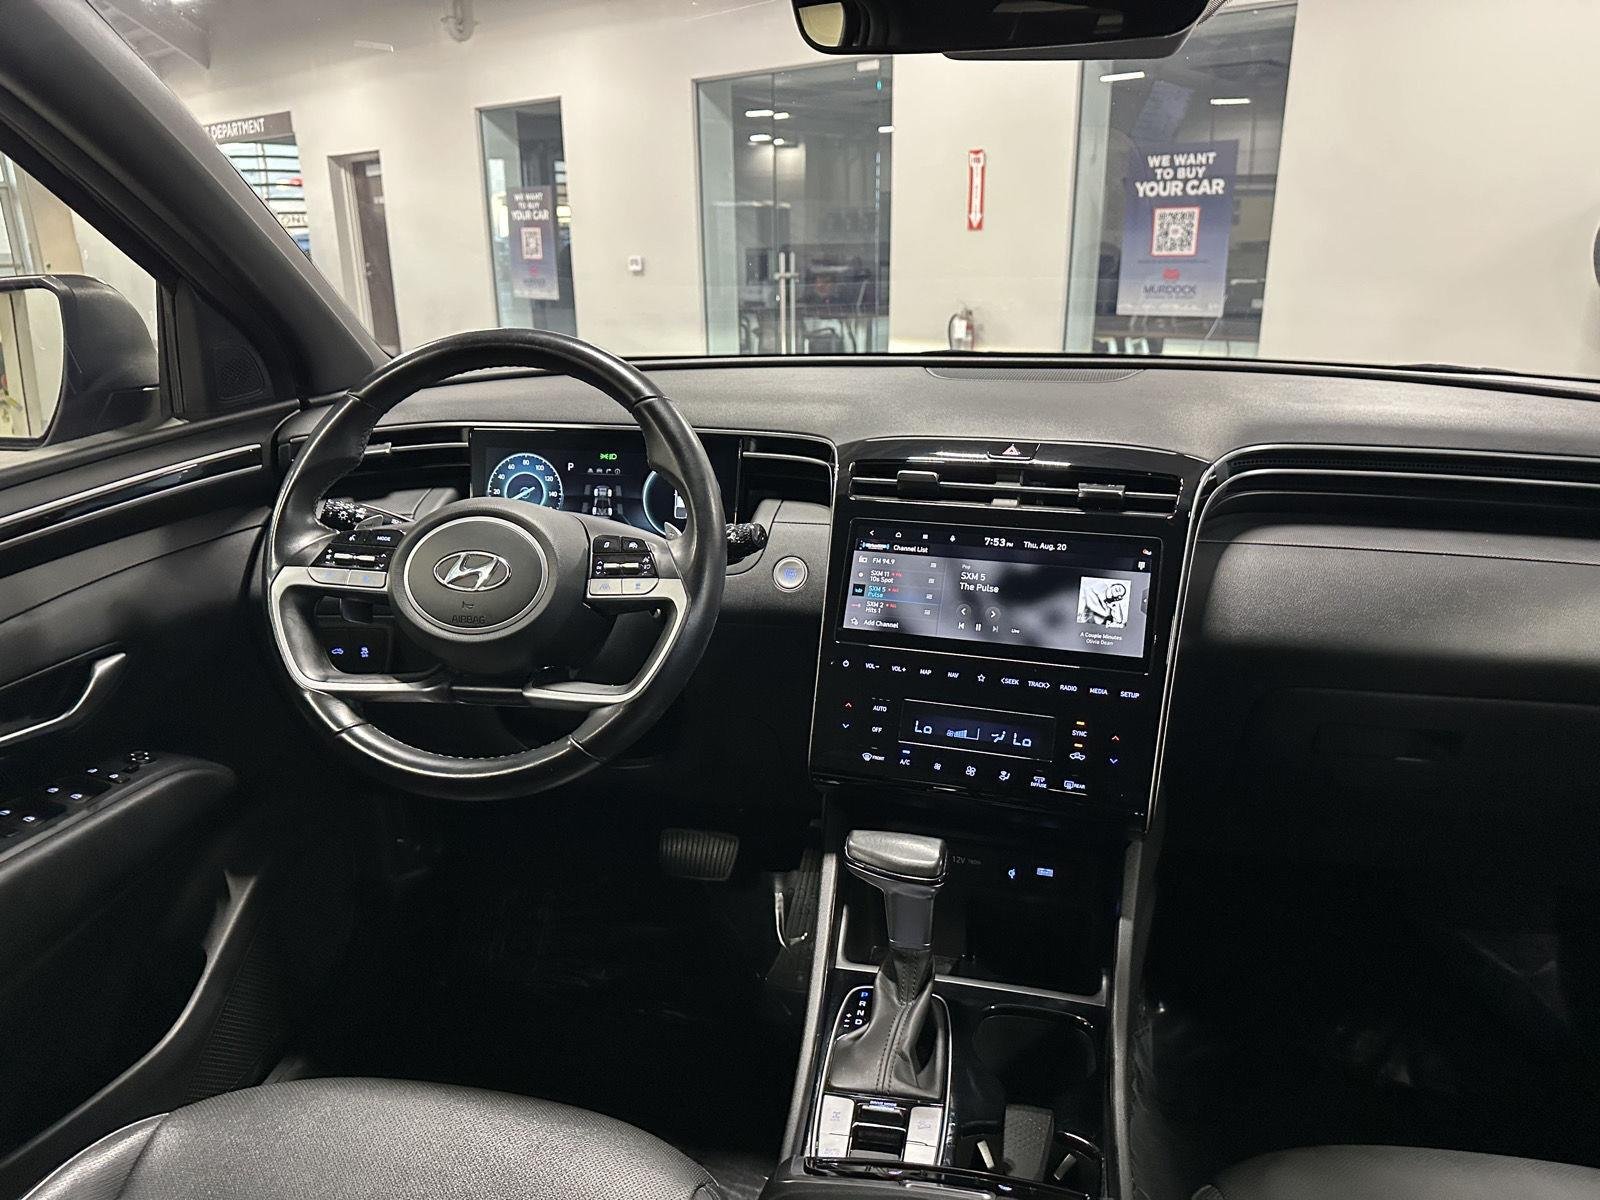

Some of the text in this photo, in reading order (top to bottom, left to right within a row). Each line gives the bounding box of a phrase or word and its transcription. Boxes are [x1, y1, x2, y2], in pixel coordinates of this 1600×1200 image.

[210, 117, 264, 139] DEPARTMENT
[1147, 152, 1217, 168] WE WANT
[1154, 166, 1206, 180] TO BUY
[1135, 178, 1226, 198] YOUR CAR
[510, 208, 550, 221] YOUR CAR
[567, 462, 575, 471] P
[984, 536, 1006, 547] 7:53
[1040, 542, 1055, 551] Aug.
[1056, 543, 1067, 551] 20
[893, 544, 916, 553] Channel
[916, 546, 929, 554] List
[870, 569, 883, 577] SXM
[960, 571, 986, 581] SXM 5
[959, 582, 1000, 593] The Pulse
[451, 615, 486, 624] AIRBAG
[875, 620, 899, 629] Channel
[1059, 684, 1078, 692] RADIO
[1089, 687, 1108, 695] MEDIA
[1119, 690, 1140, 699] SETUP
[872, 705, 887, 713] AUTO
[1071, 729, 1088, 738] SYNC
[899, 758, 911, 766] A/C
[952, 855, 966, 864] 12V
